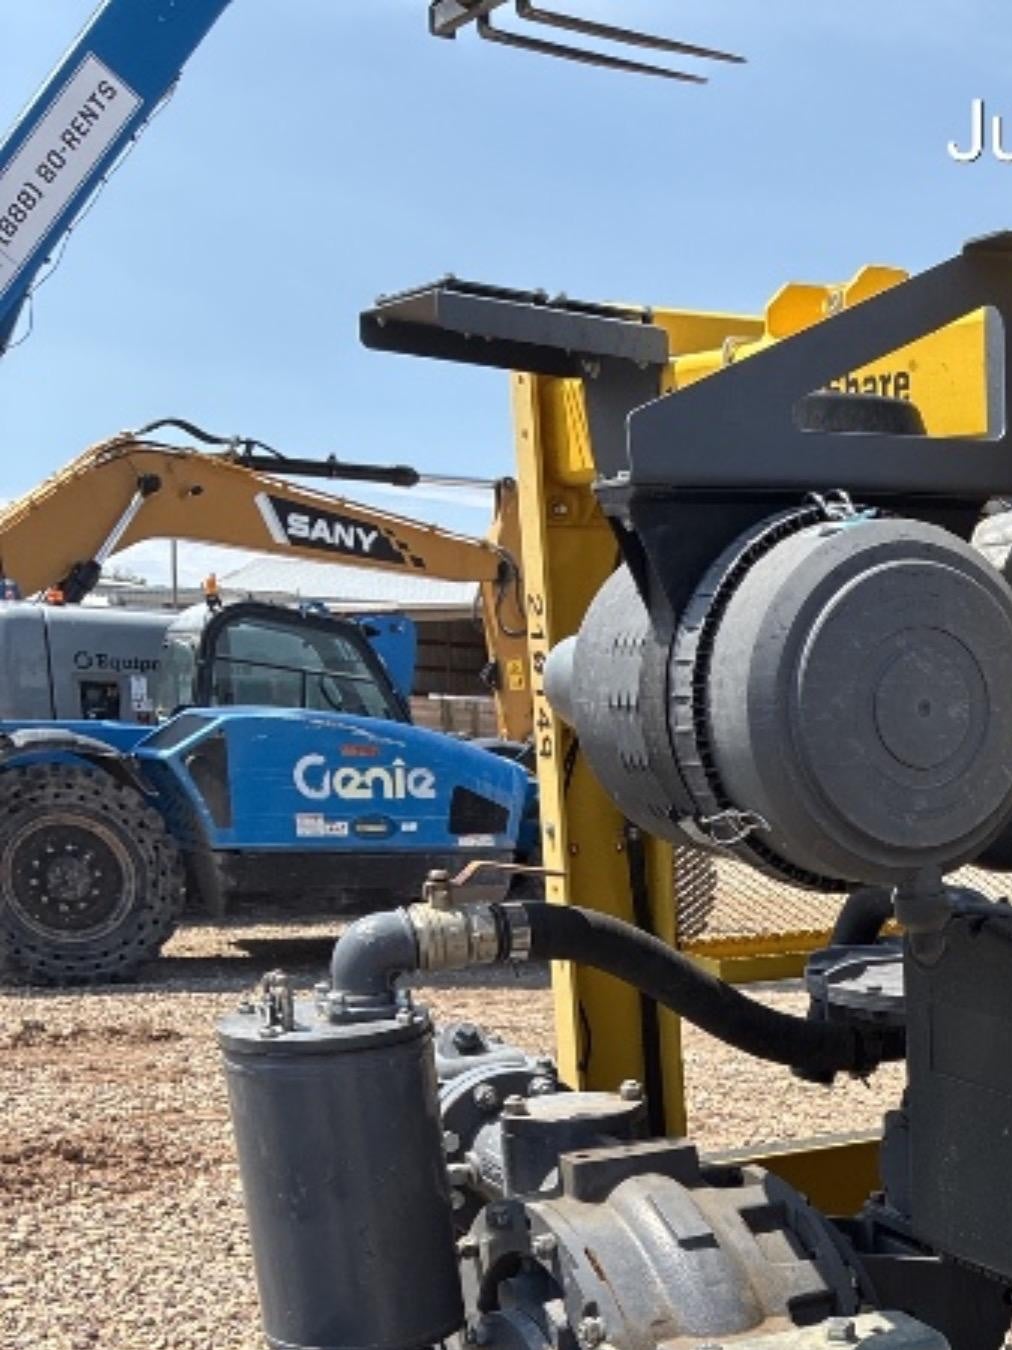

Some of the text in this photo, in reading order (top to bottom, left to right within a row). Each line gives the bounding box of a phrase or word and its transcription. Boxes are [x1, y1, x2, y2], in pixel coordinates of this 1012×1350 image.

[36, 79, 118, 184] 80-RENTS
[286, 511, 378, 553] SANY
[293, 752, 436, 800] Genie
